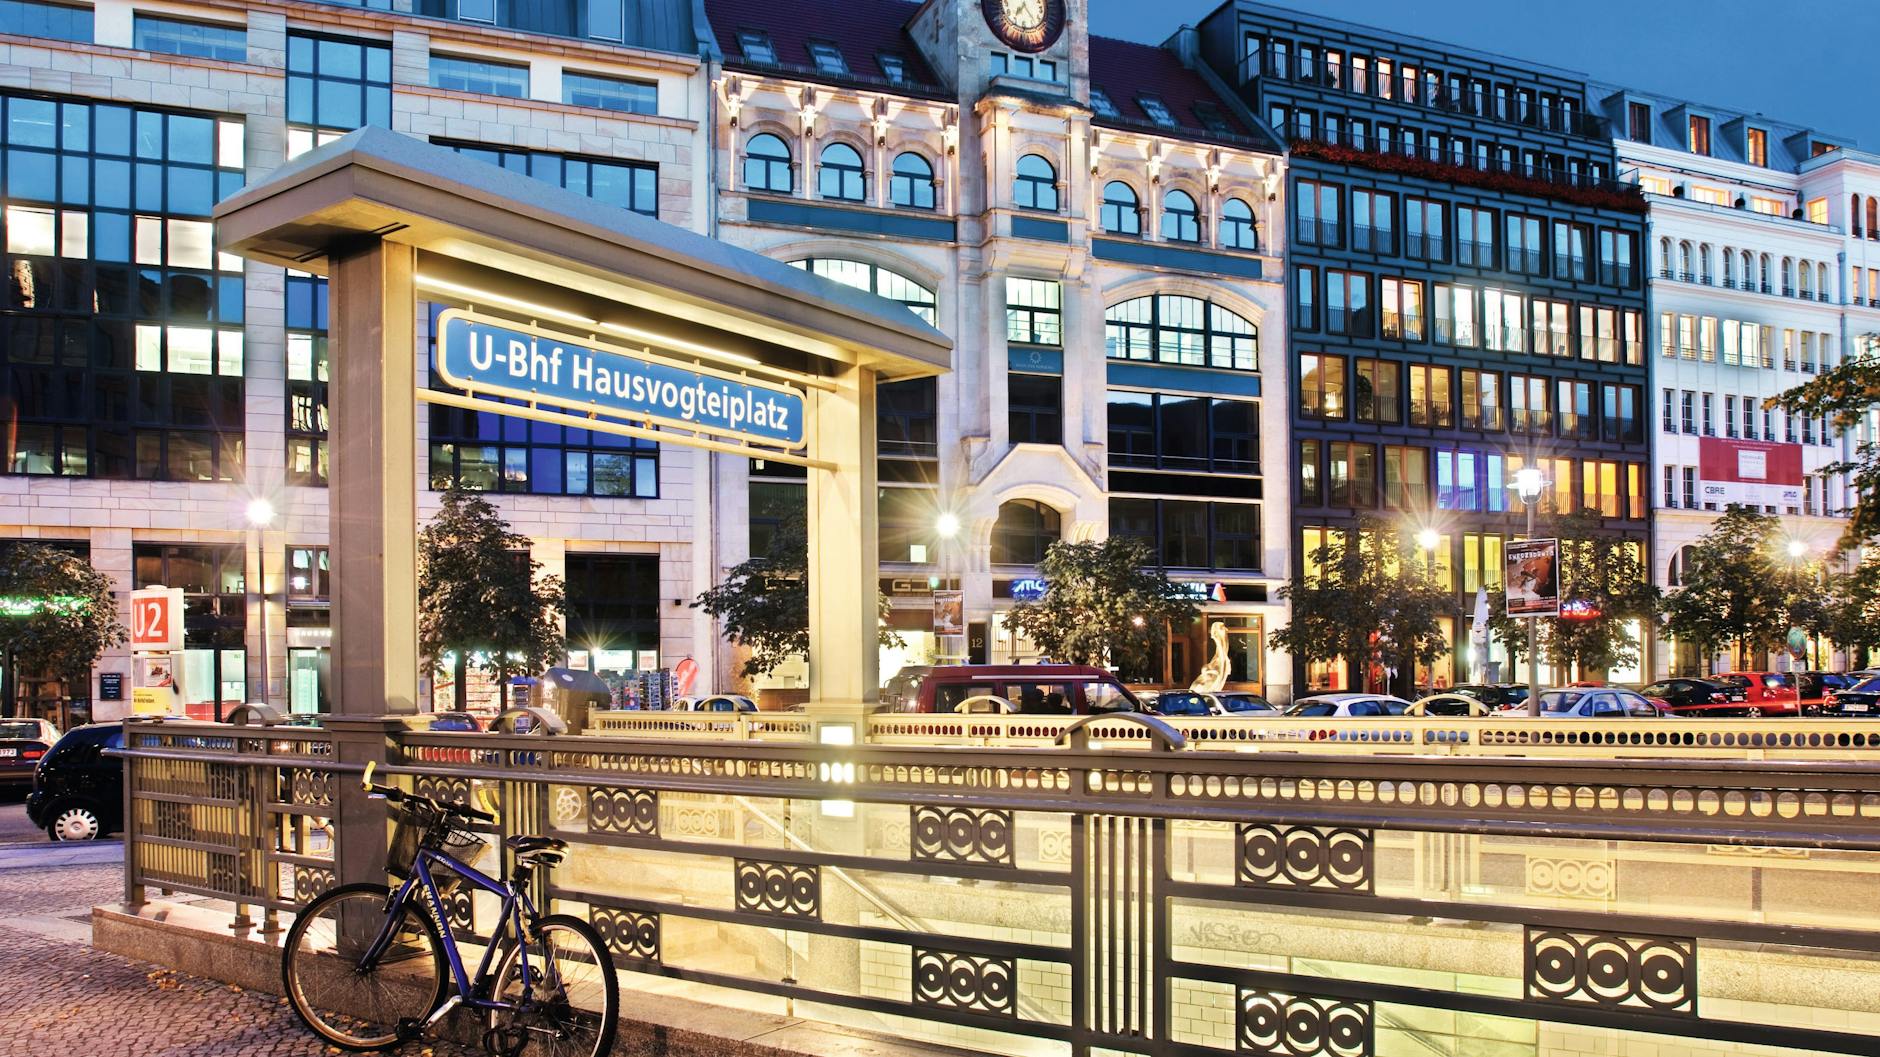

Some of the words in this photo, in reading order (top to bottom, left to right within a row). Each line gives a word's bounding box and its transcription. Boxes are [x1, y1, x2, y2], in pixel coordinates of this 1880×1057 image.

[469, 331, 563, 384] U-Bhf
[572, 354, 789, 431] Hausvogteiplatz
[1704, 486, 1725, 495] CBRE
[133, 602, 163, 638] U2
[971, 637, 983, 648] 12
[422, 884, 447, 939] SHANNON
